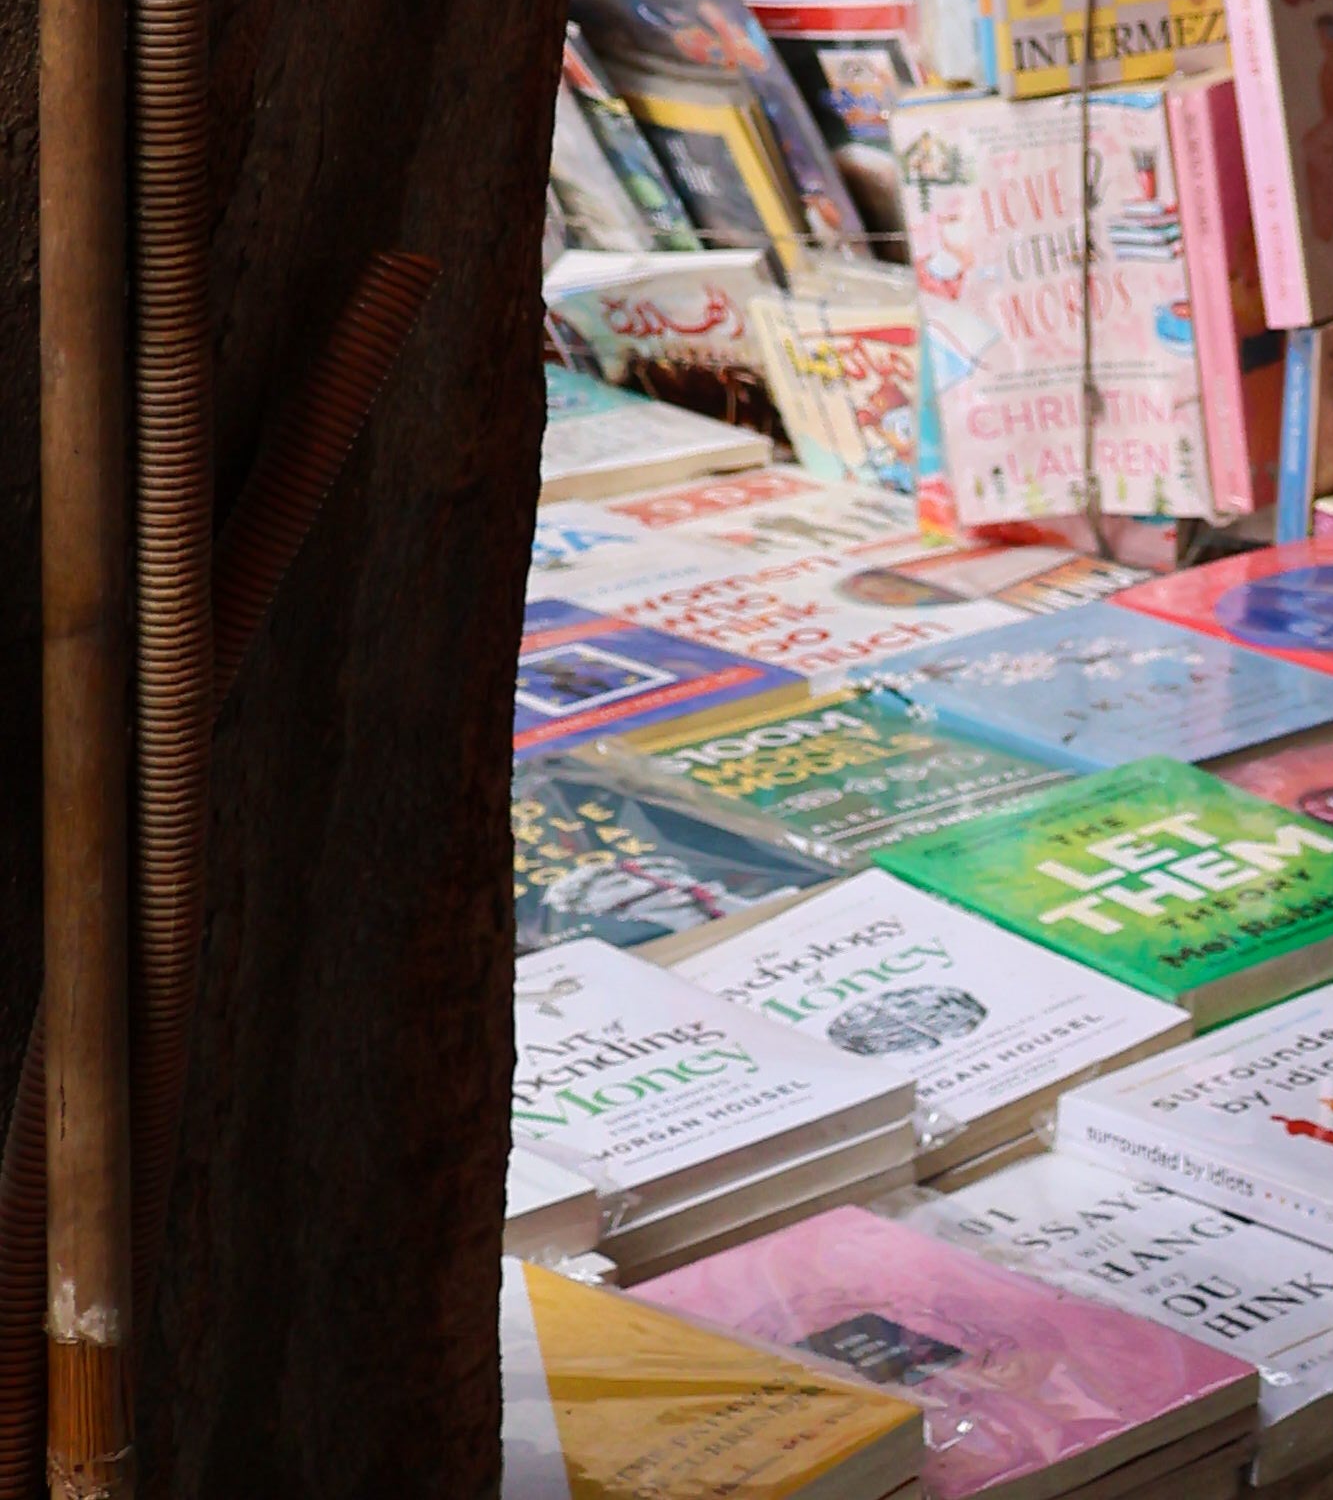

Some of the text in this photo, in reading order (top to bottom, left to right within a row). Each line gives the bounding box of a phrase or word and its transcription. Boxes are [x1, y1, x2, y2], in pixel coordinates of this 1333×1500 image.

[979, 166, 1066, 235] LOVE
[1035, 811, 1219, 893] LET
[524, 1029, 600, 1067] Art
[705, 1078, 812, 1122] HOUSEL
[1210, 1089, 1272, 1116] by
[1085, 1125, 1256, 1198] surrounded by idiots
